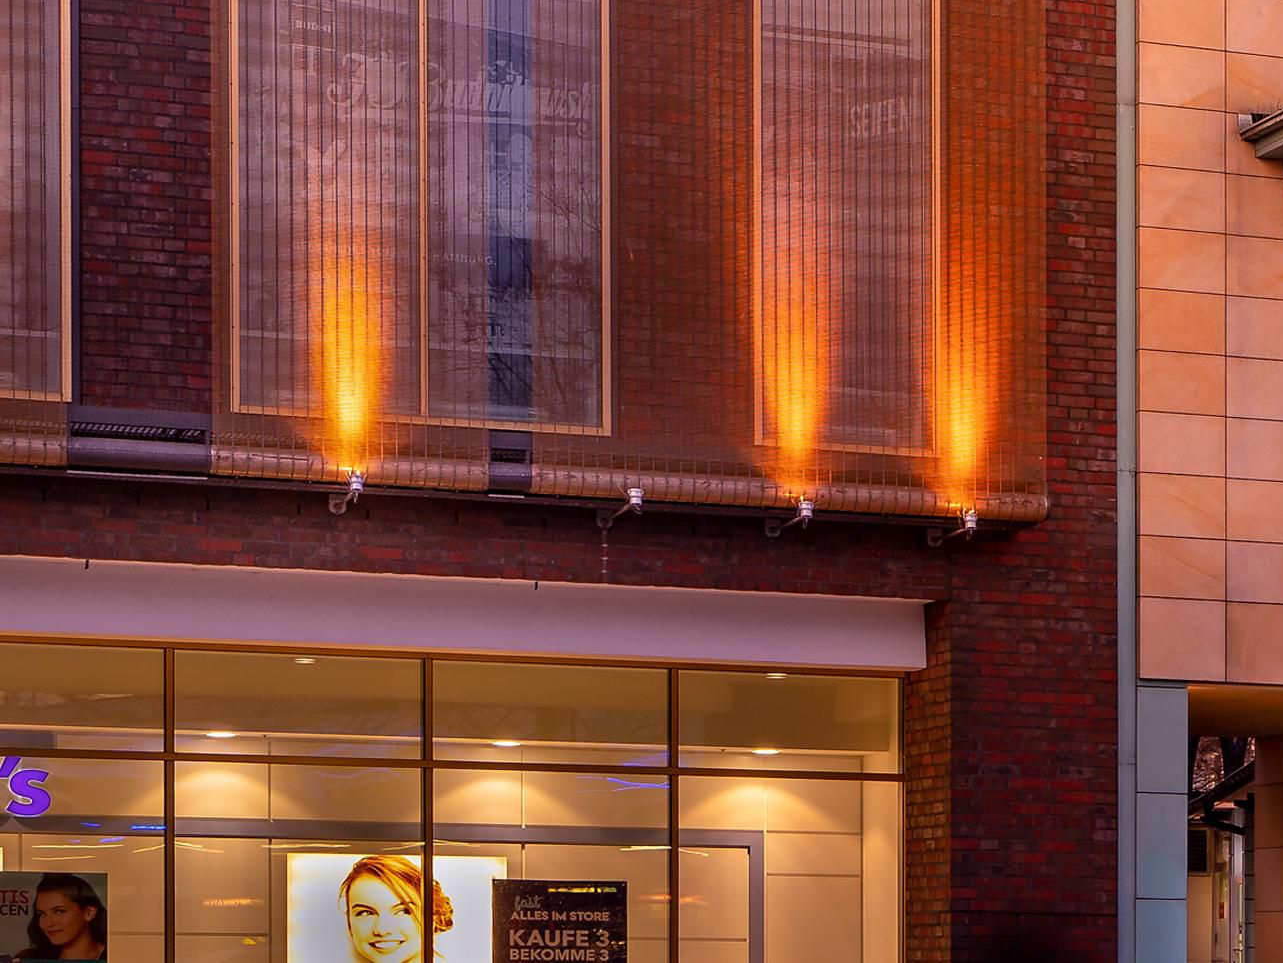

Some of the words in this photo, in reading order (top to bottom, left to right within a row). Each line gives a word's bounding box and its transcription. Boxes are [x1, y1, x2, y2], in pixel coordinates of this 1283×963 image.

[515, 895, 544, 911] fast
[510, 911, 549, 921] ALLES
[552, 912, 566, 921] IM
[569, 911, 609, 921] STORE
[509, 929, 589, 947] KAUFE
[595, 930, 610, 947] 3
[509, 948, 595, 961] BEKOMME
[599, 949, 609, 961] 3
